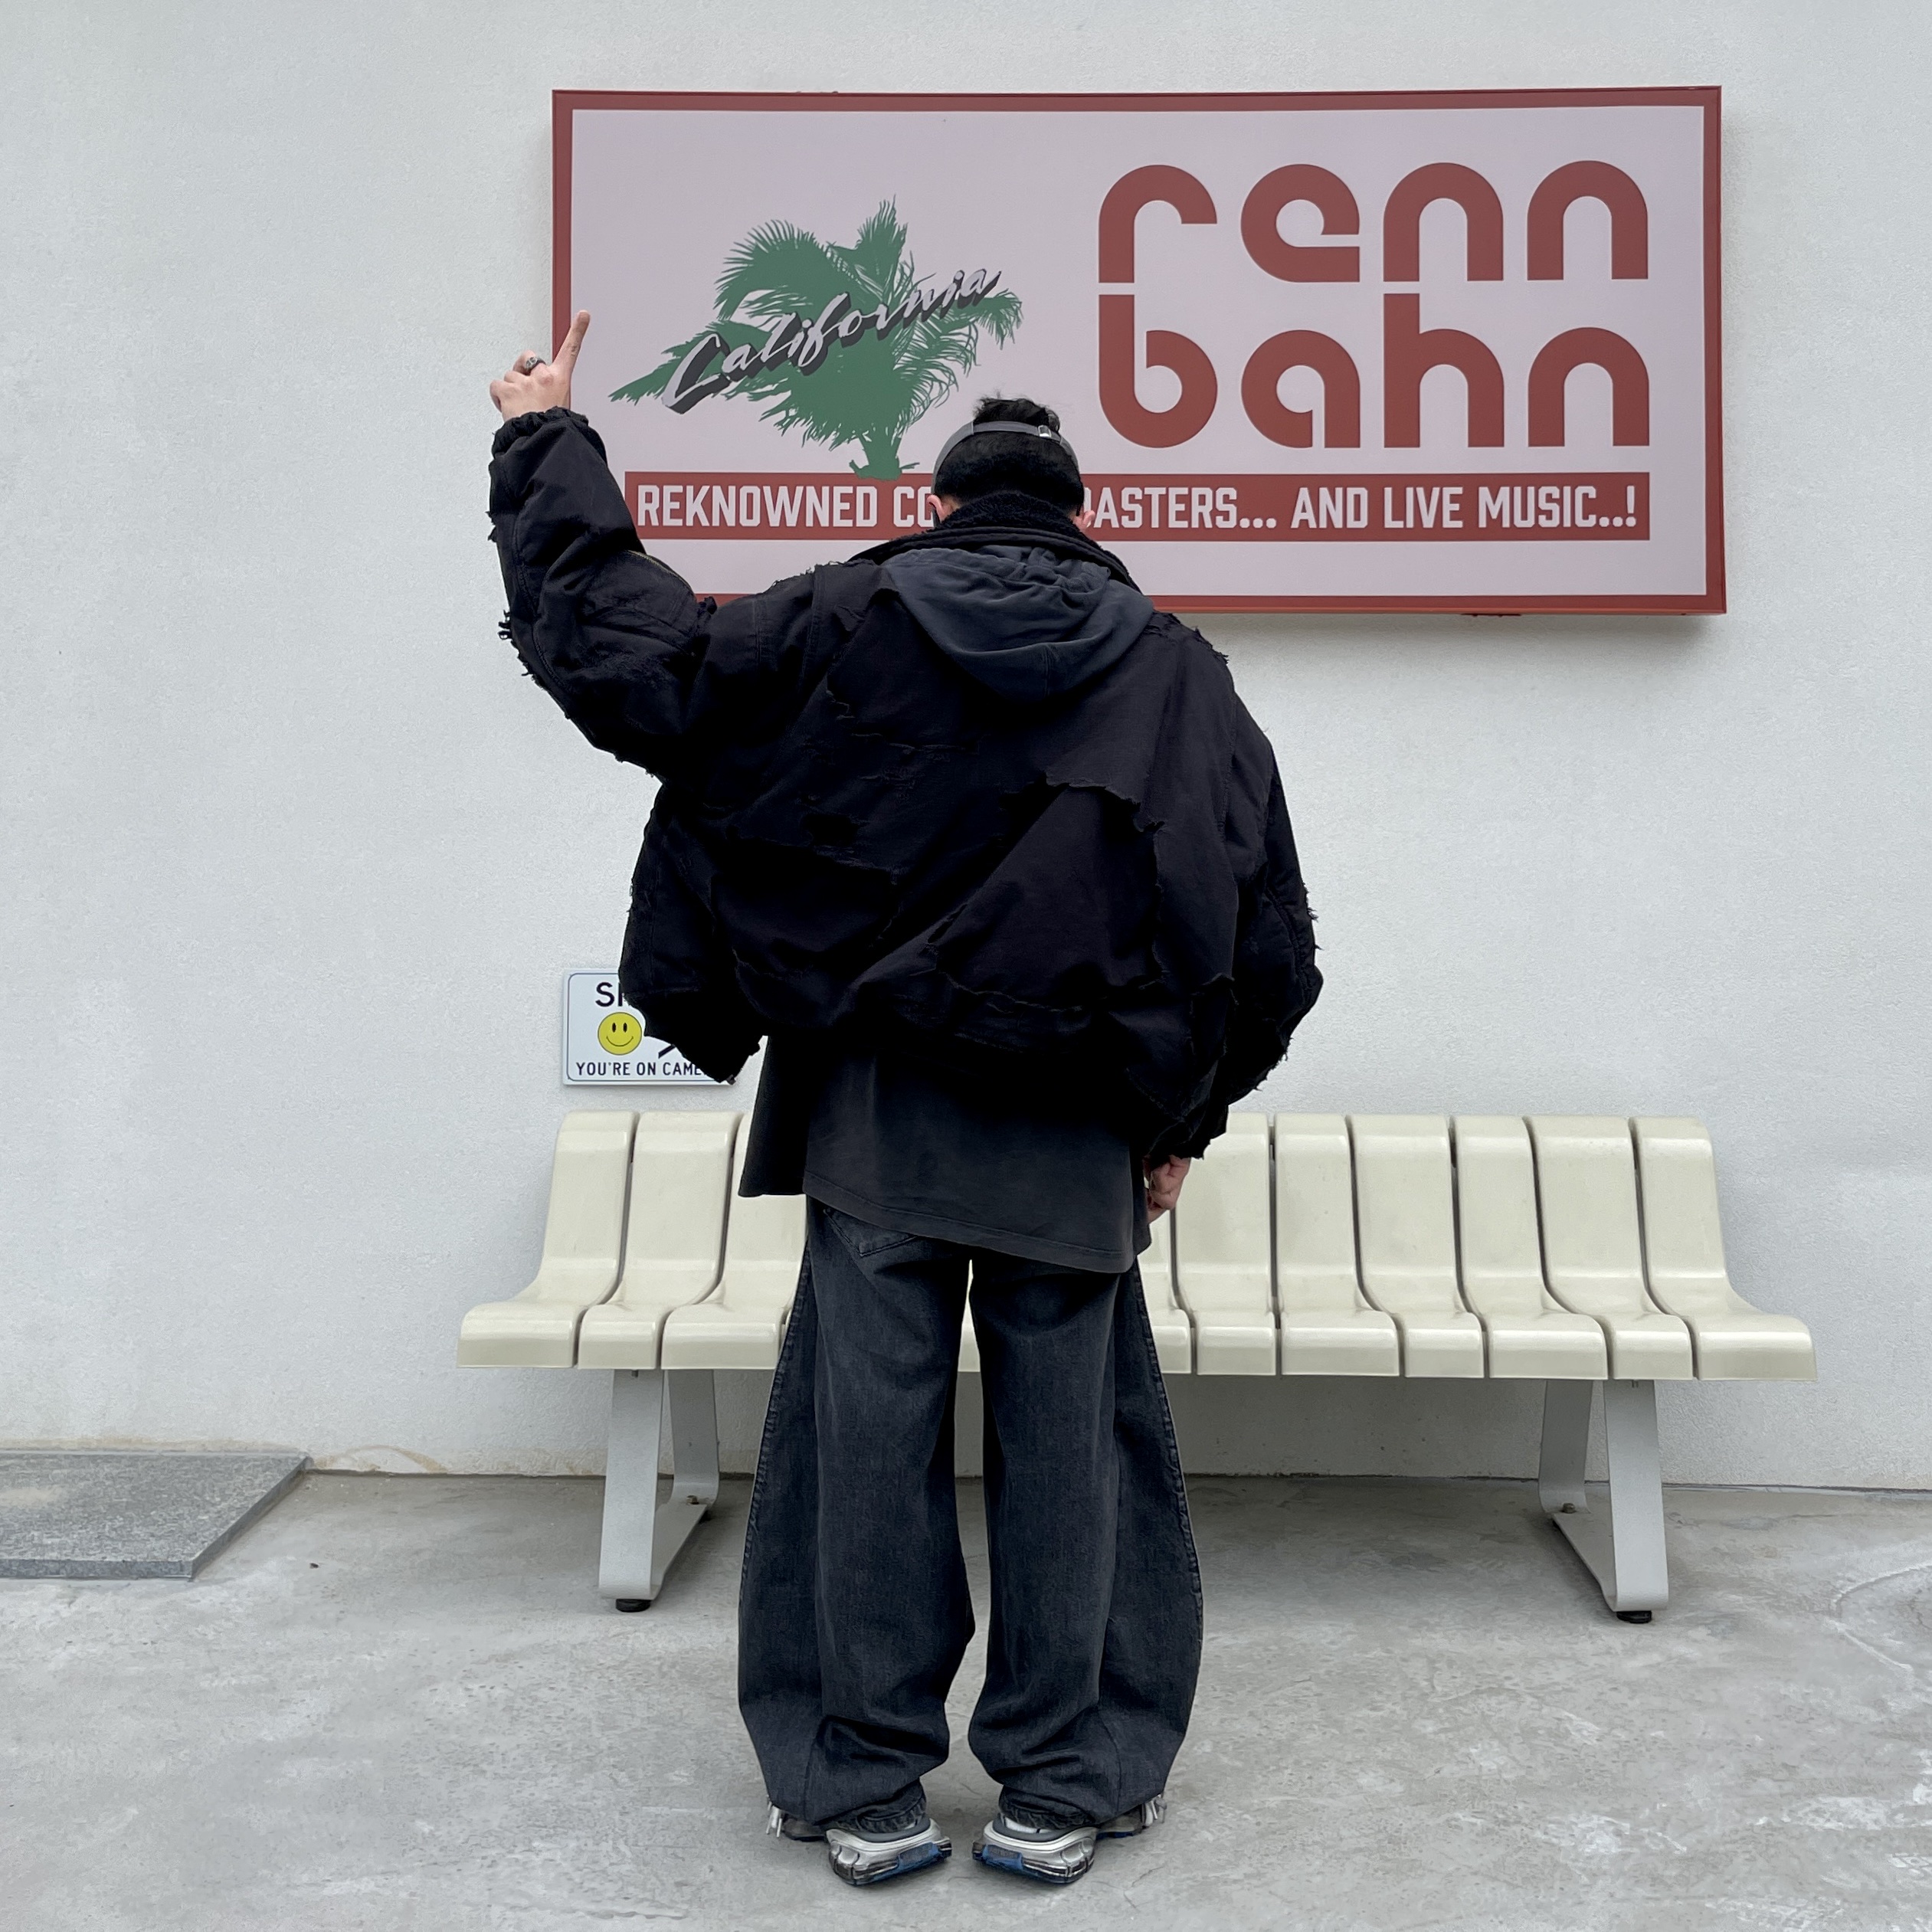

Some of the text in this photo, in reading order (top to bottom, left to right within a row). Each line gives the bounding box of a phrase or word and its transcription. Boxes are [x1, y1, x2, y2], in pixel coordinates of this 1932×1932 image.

[1099, 161, 1649, 283] renn
[661, 268, 1002, 414] California
[1099, 293, 1650, 449] bahn
[637, 485, 878, 527] REKNOWNED
[1291, 486, 1369, 529] AND
[1384, 486, 1464, 529] LIVE
[576, 1062, 630, 1076] YOU'RE
[637, 1062, 656, 1076] ON
